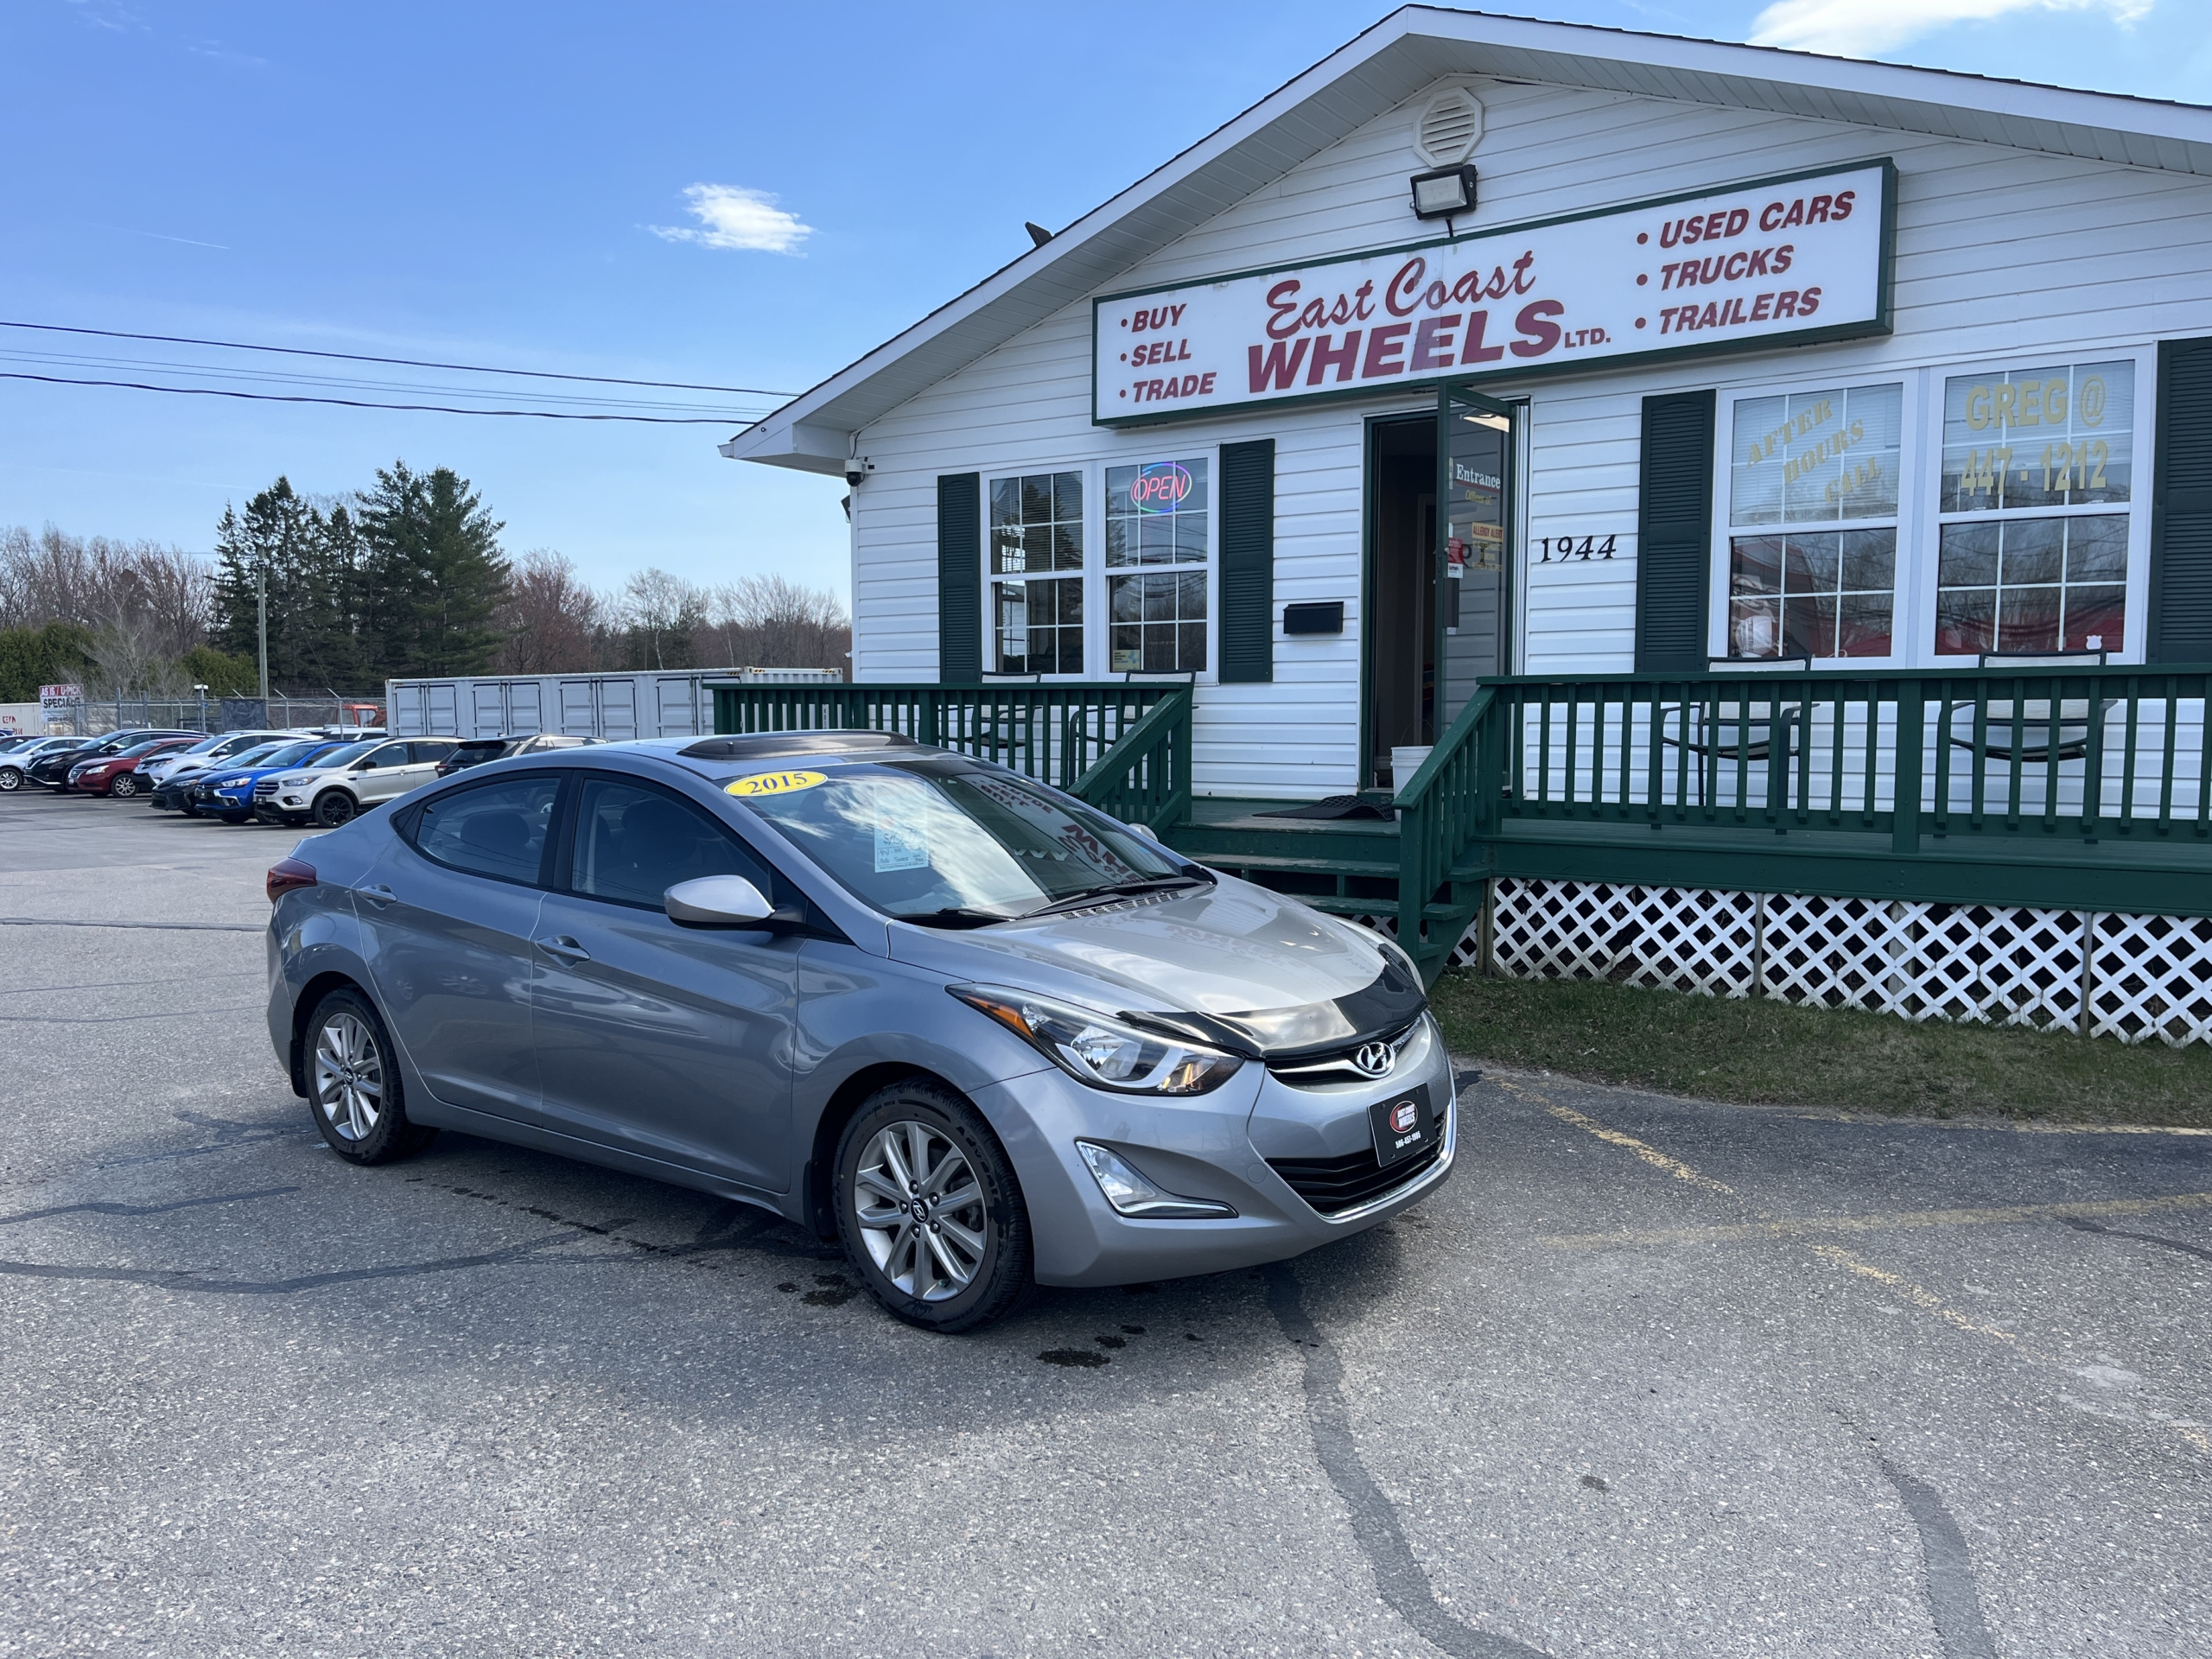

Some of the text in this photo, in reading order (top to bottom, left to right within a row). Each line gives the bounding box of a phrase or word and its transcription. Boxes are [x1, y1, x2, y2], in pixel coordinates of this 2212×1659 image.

[1660, 191, 1855, 248] USED CARS
[1660, 245, 1794, 291] TRUCKS
[1132, 303, 1185, 333] BUY
[1266, 251, 1535, 340] East Coast
[1660, 287, 1821, 334] TRAILERS
[1131, 339, 1192, 367] SELL
[1248, 299, 1611, 393] WHEELS LTD.
[1133, 372, 1217, 403] TRADE
[1965, 378, 2068, 430] GREG
[1746, 398, 1833, 468] AFTER
[1783, 418, 1866, 486] HOURS
[1134, 474, 1186, 501] OPEN
[1456, 463, 1501, 489] Entrance
[1824, 456, 1882, 504] CALL
[1472, 524, 1490, 537] ALLERGY
[1541, 534, 1617, 563] 1944
[747, 773, 808, 794] 2015
